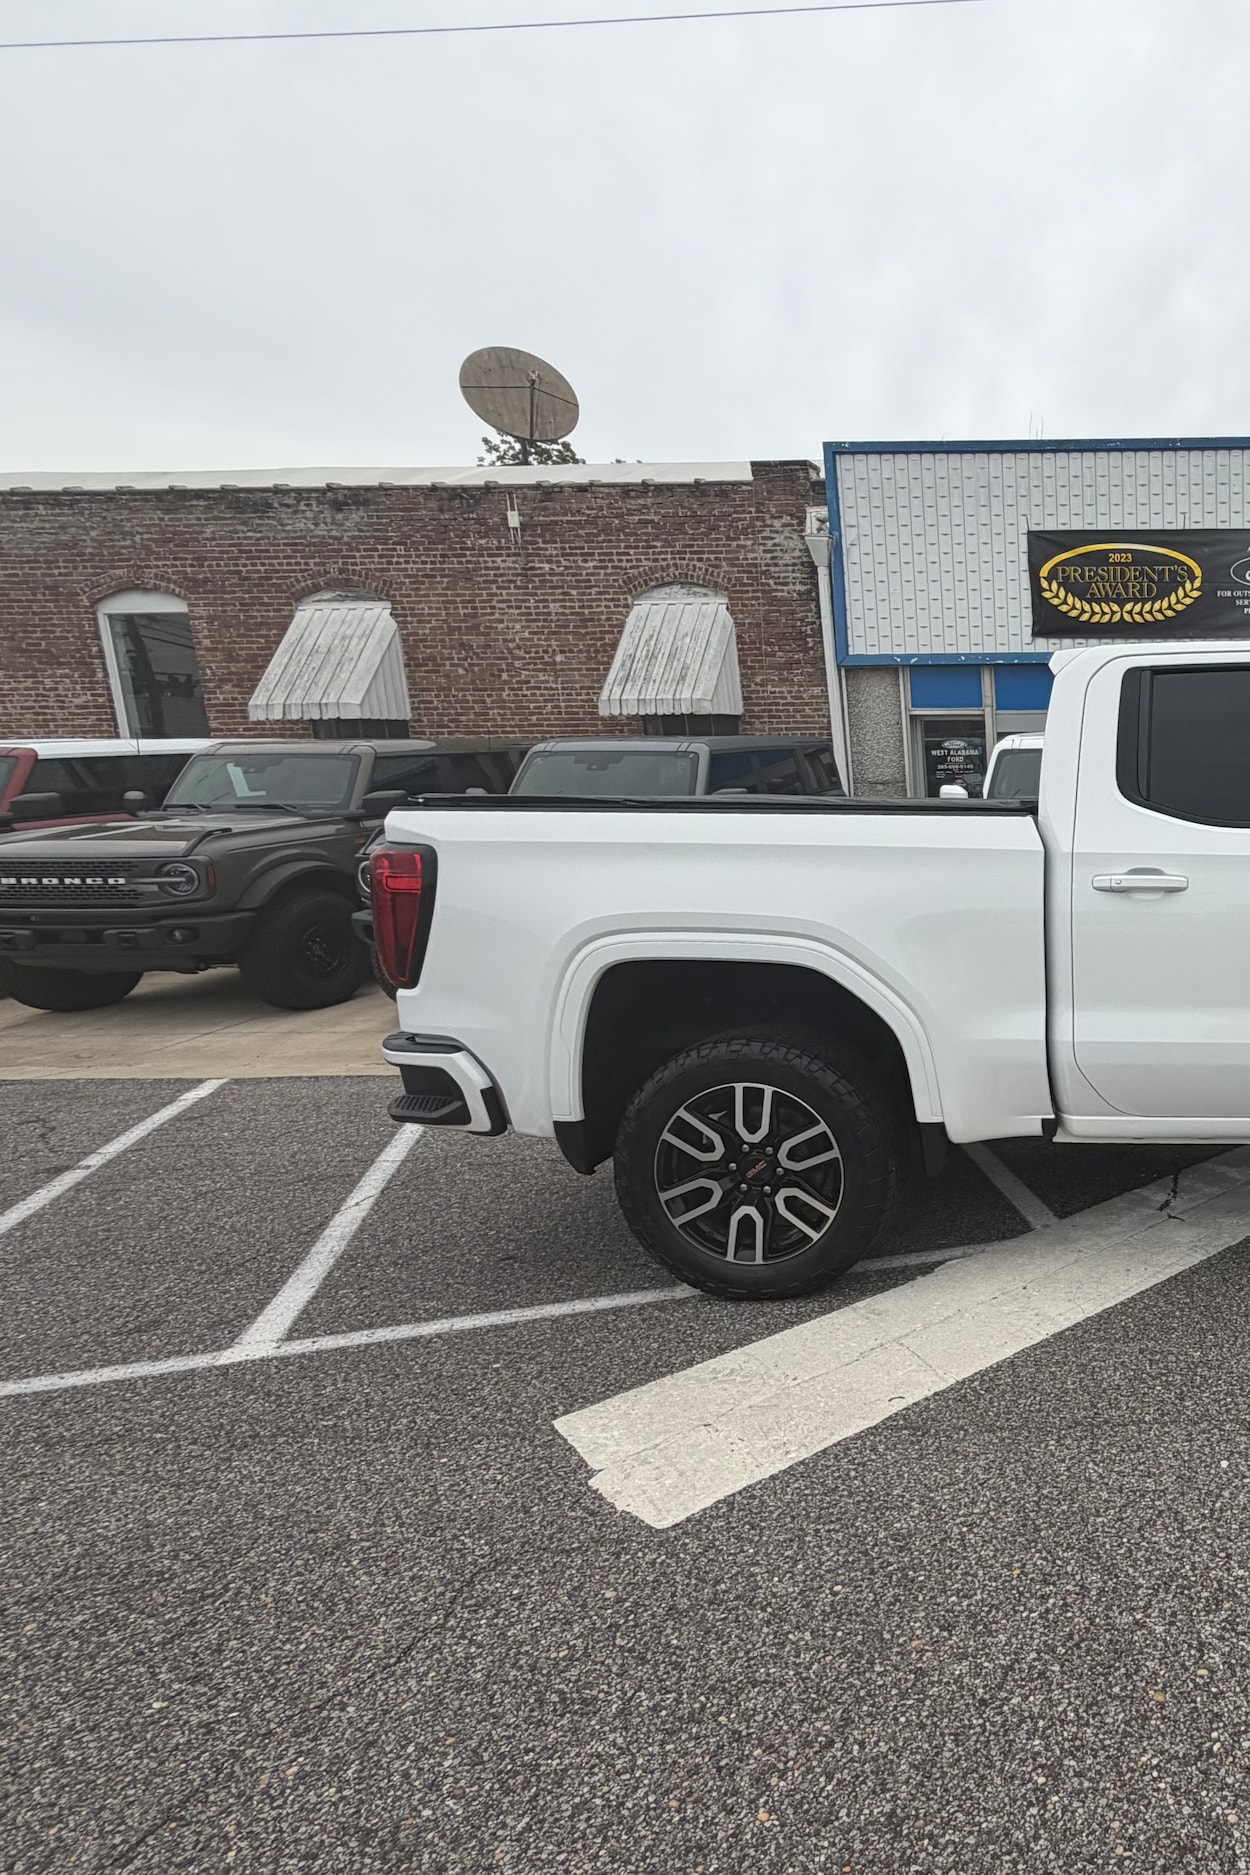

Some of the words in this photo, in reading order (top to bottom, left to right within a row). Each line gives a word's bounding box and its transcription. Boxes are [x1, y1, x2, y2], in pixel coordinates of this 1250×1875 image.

[1108, 553, 1132, 563] 2023
[1057, 565, 1189, 583] PRESIDENT'S
[1085, 582, 1157, 599] AWARD
[1, 877, 126, 885] BRONCO
[745, 1160, 768, 1179] GMC
